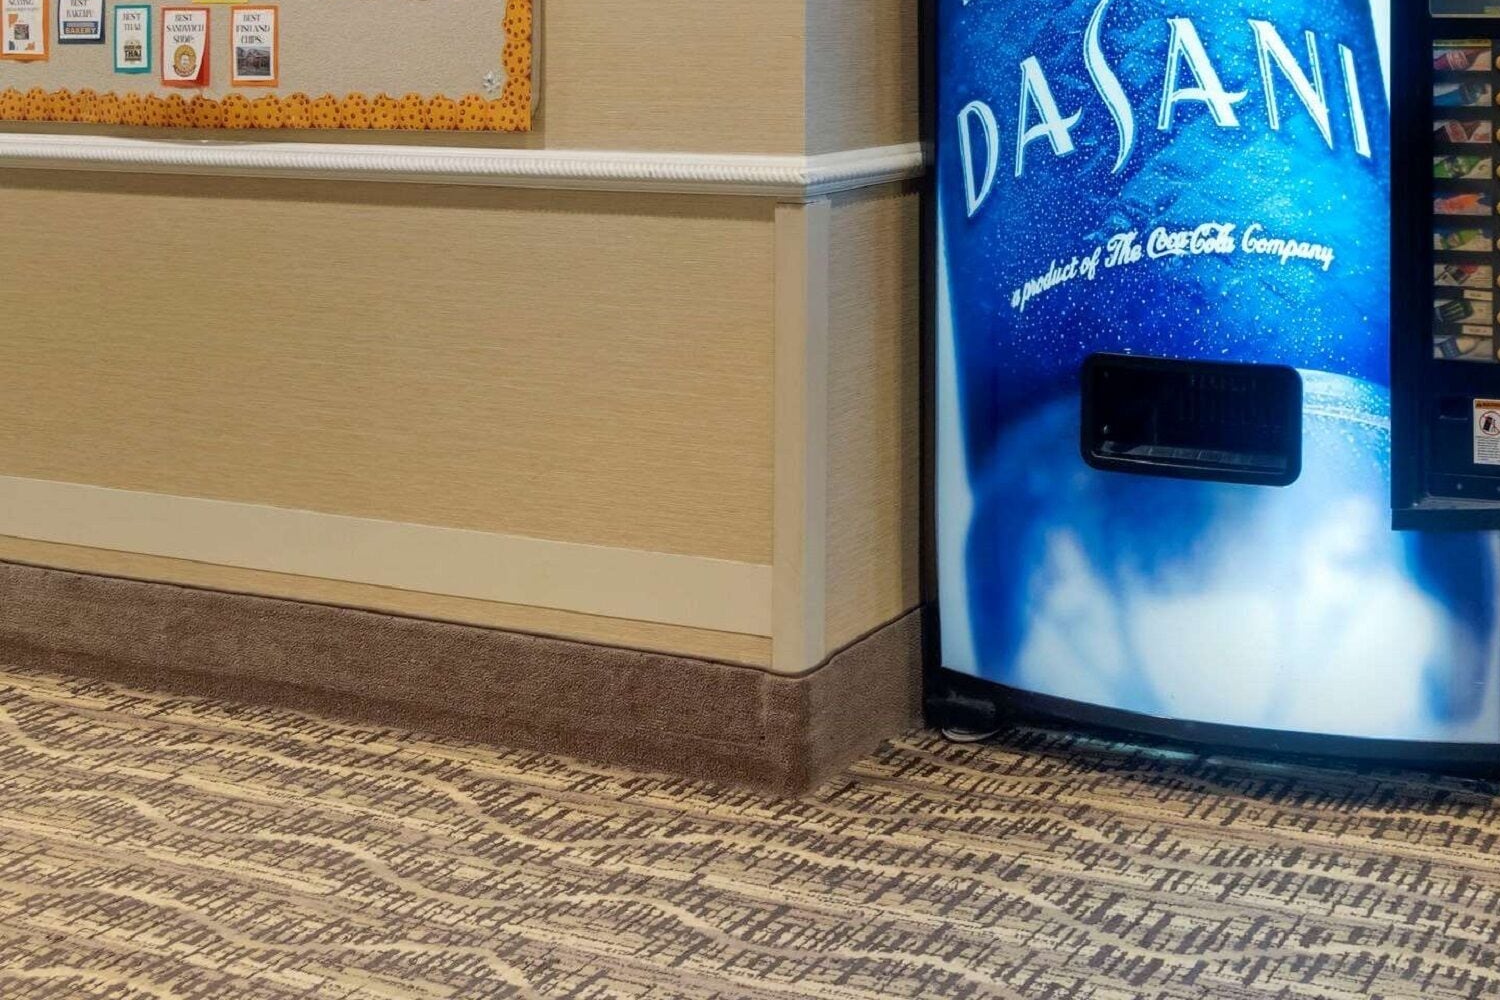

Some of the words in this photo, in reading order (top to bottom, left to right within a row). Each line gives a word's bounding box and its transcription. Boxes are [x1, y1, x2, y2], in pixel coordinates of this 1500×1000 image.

[125, 50, 142, 58] THAI
[1019, 255, 1080, 313] product
[1079, 247, 1101, 280] of
[1104, 230, 1142, 268] The
[1147, 221, 1236, 259] Coca-Cola
[1241, 223, 1335, 272] Company
